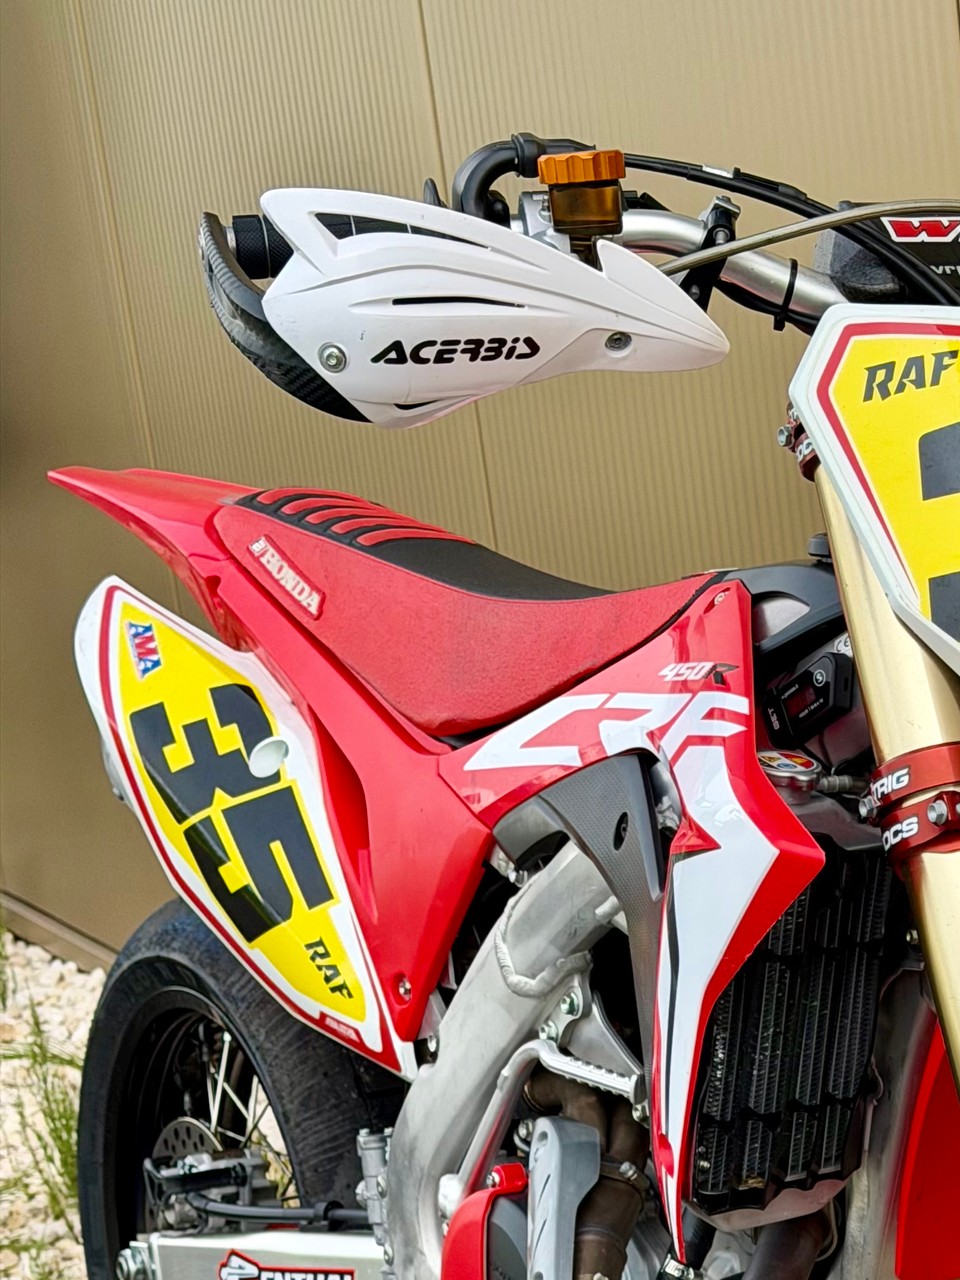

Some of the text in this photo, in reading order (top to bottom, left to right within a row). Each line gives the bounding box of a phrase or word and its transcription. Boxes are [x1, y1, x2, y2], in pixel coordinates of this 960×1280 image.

[371, 336, 540, 365] ACERBIS
[862, 349, 960, 402] RAF
[259, 548, 321, 616] HONDA
[128, 621, 162, 679] AMA
[463, 691, 749, 771] CRF
[130, 683, 335, 943] 35
[304, 936, 354, 999] RAF
